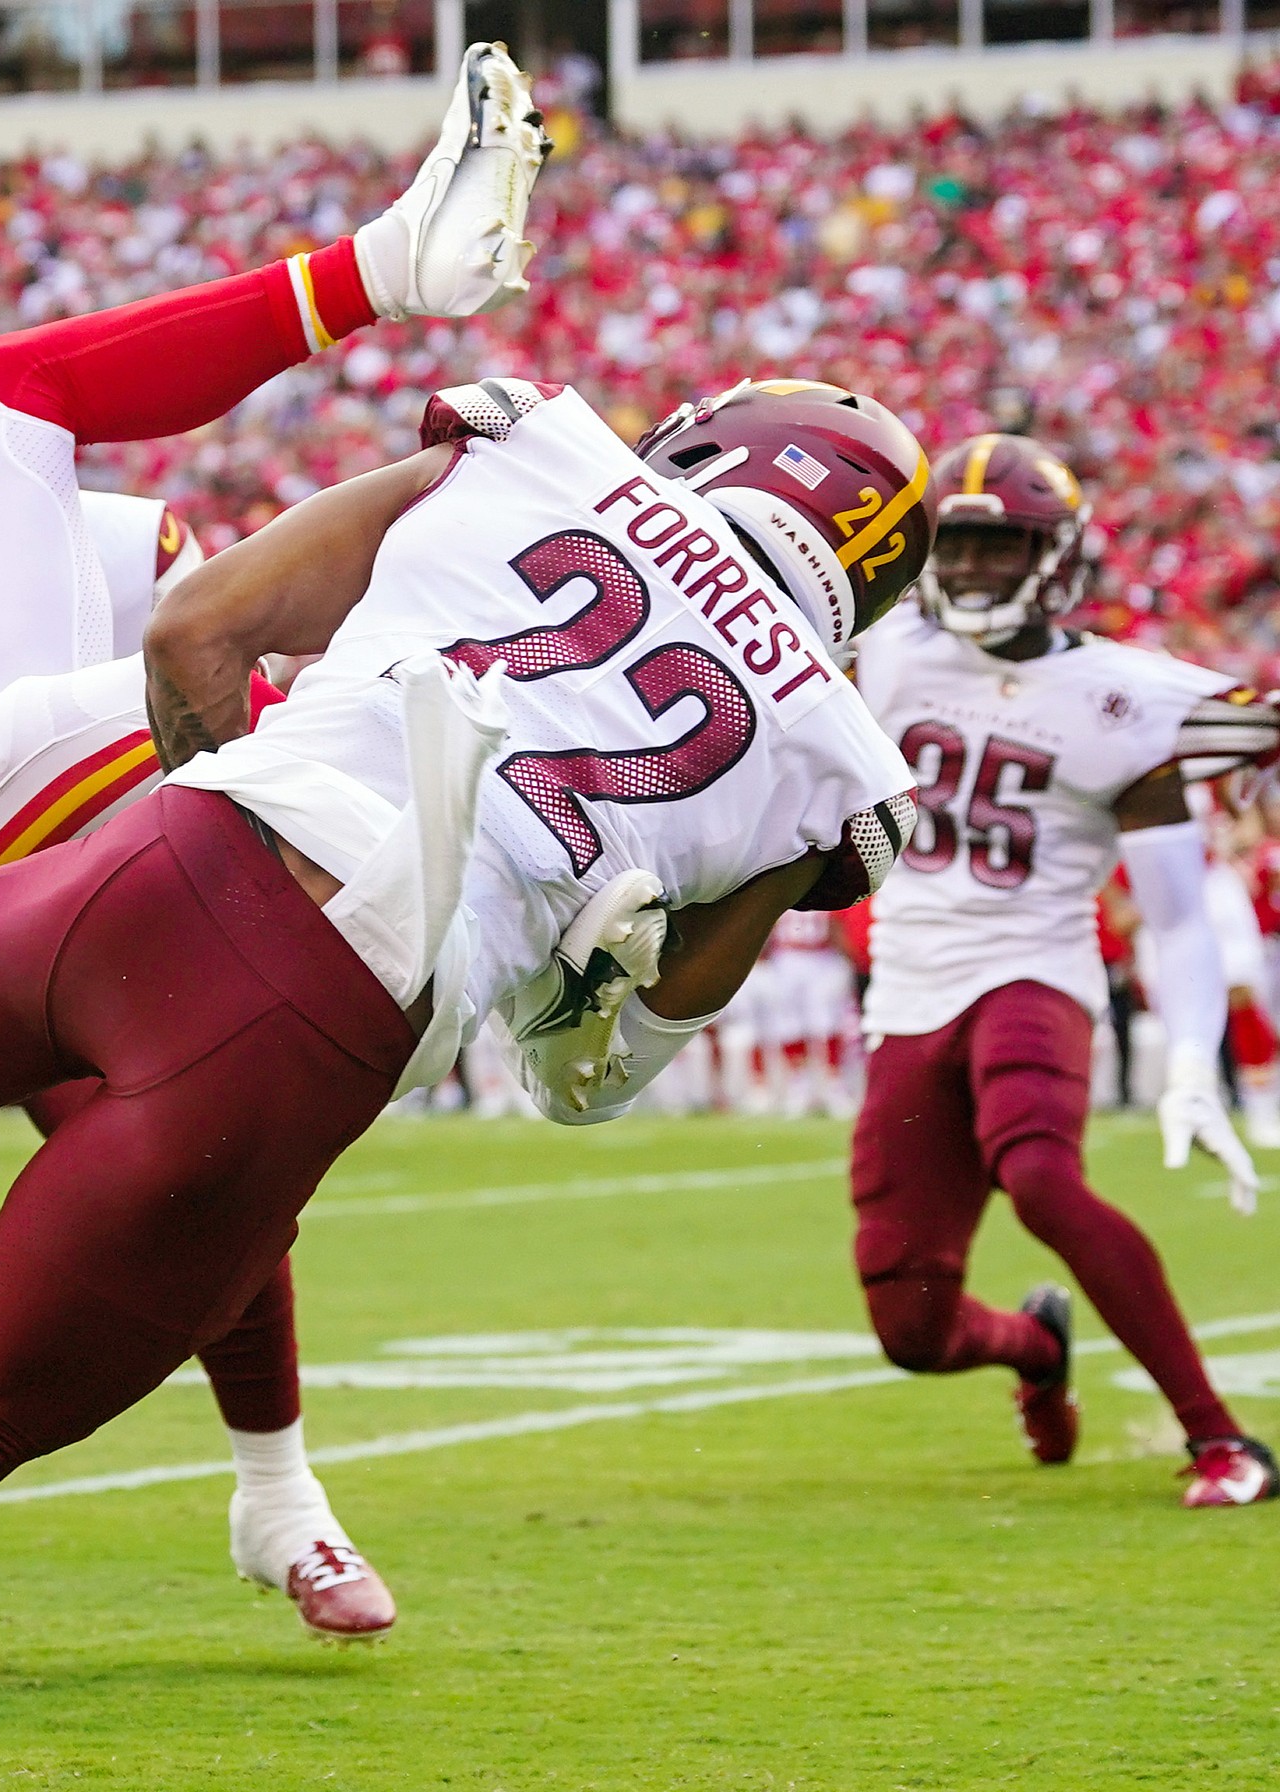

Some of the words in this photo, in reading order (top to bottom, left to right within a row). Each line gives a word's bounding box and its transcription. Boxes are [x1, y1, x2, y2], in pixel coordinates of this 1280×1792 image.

[592, 475, 832, 704] FORREST
[770, 512, 844, 644] WASHINGTON
[832, 486, 907, 583] 22
[382, 528, 758, 880] 22
[899, 718, 1058, 890] 35
